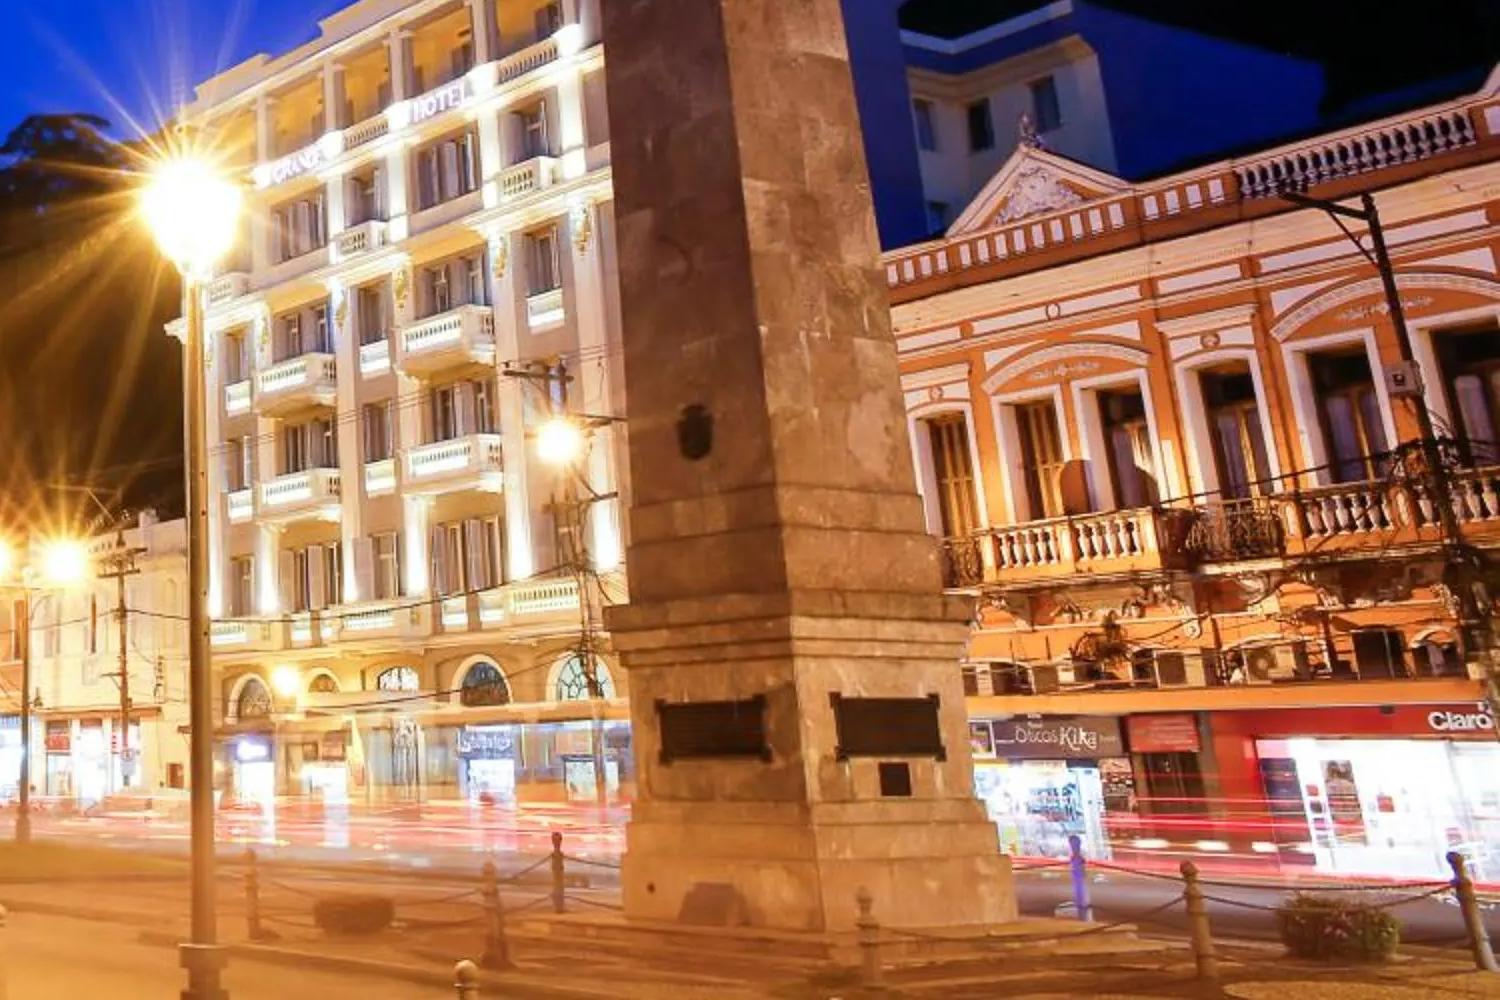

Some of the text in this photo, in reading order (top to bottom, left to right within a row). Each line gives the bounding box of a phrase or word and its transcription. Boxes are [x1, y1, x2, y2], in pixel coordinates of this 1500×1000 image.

[412, 83, 473, 123] HOTEL
[1427, 711, 1493, 730] Claro
[1059, 726, 1098, 751] Kika
